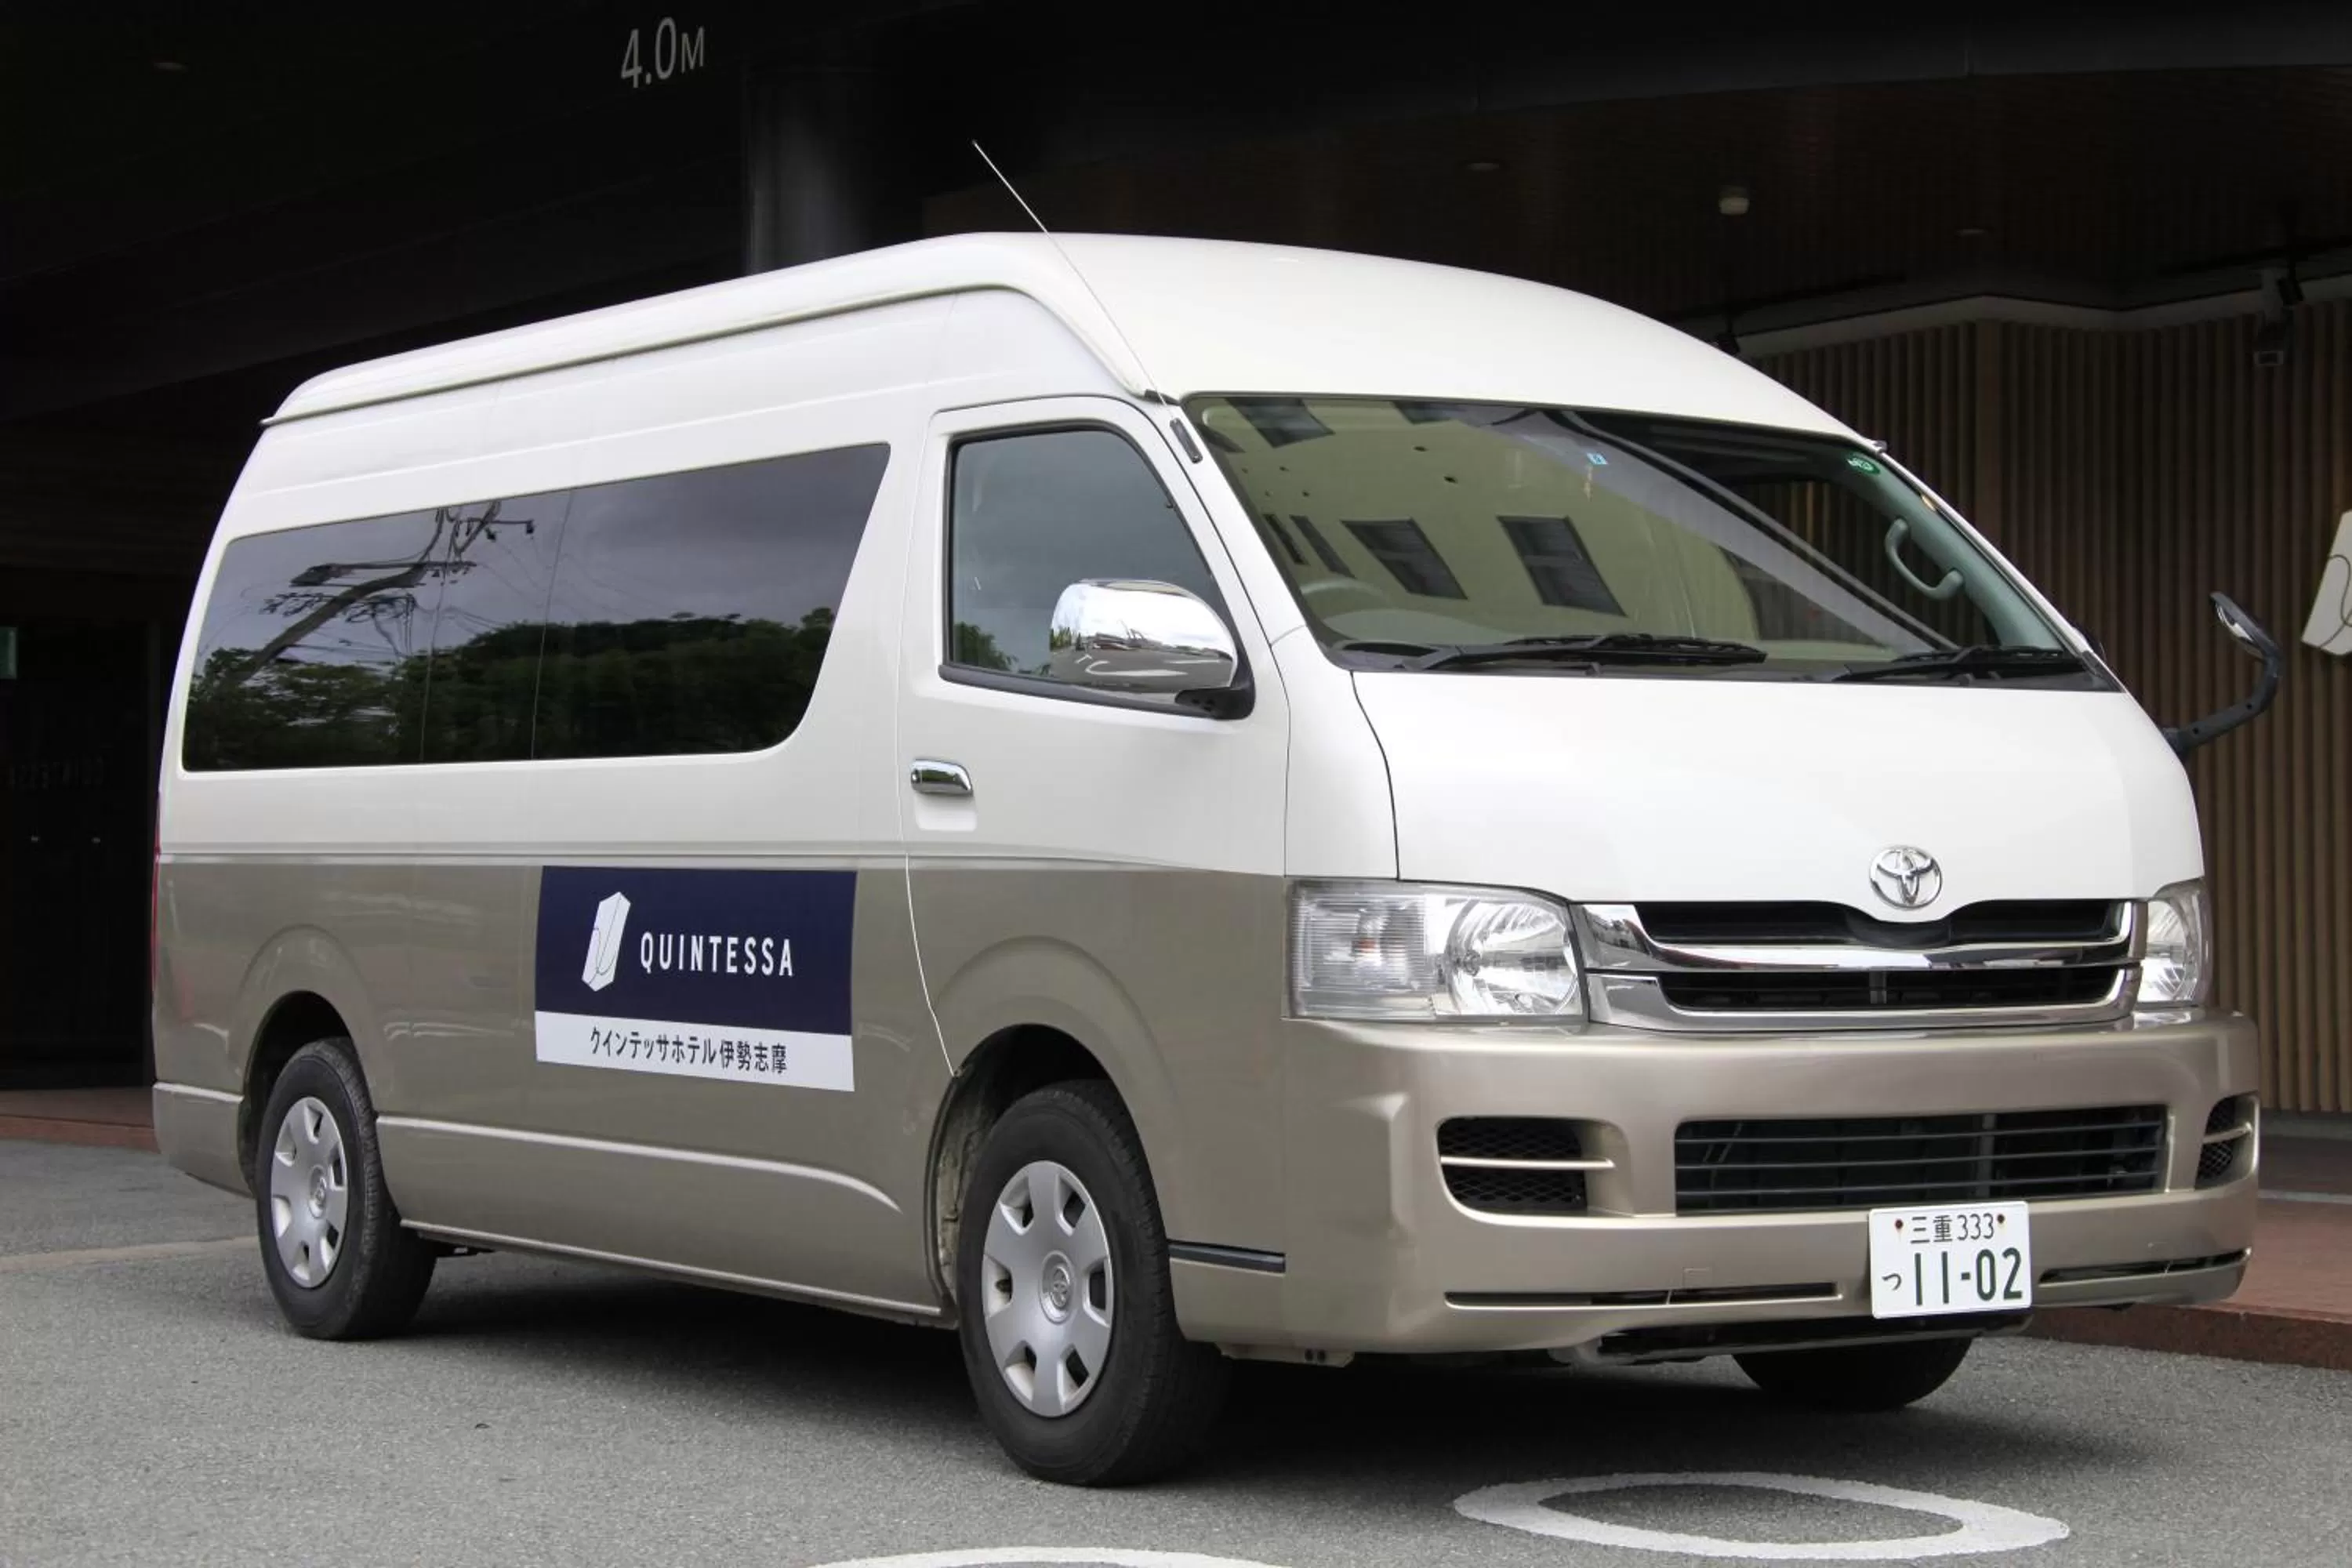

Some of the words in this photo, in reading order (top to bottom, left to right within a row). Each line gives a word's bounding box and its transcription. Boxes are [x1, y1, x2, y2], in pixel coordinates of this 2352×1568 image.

[640, 931, 793, 977] QUINTESSA
[590, 1025, 788, 1074] クインテッサホテル伊勢志摩
